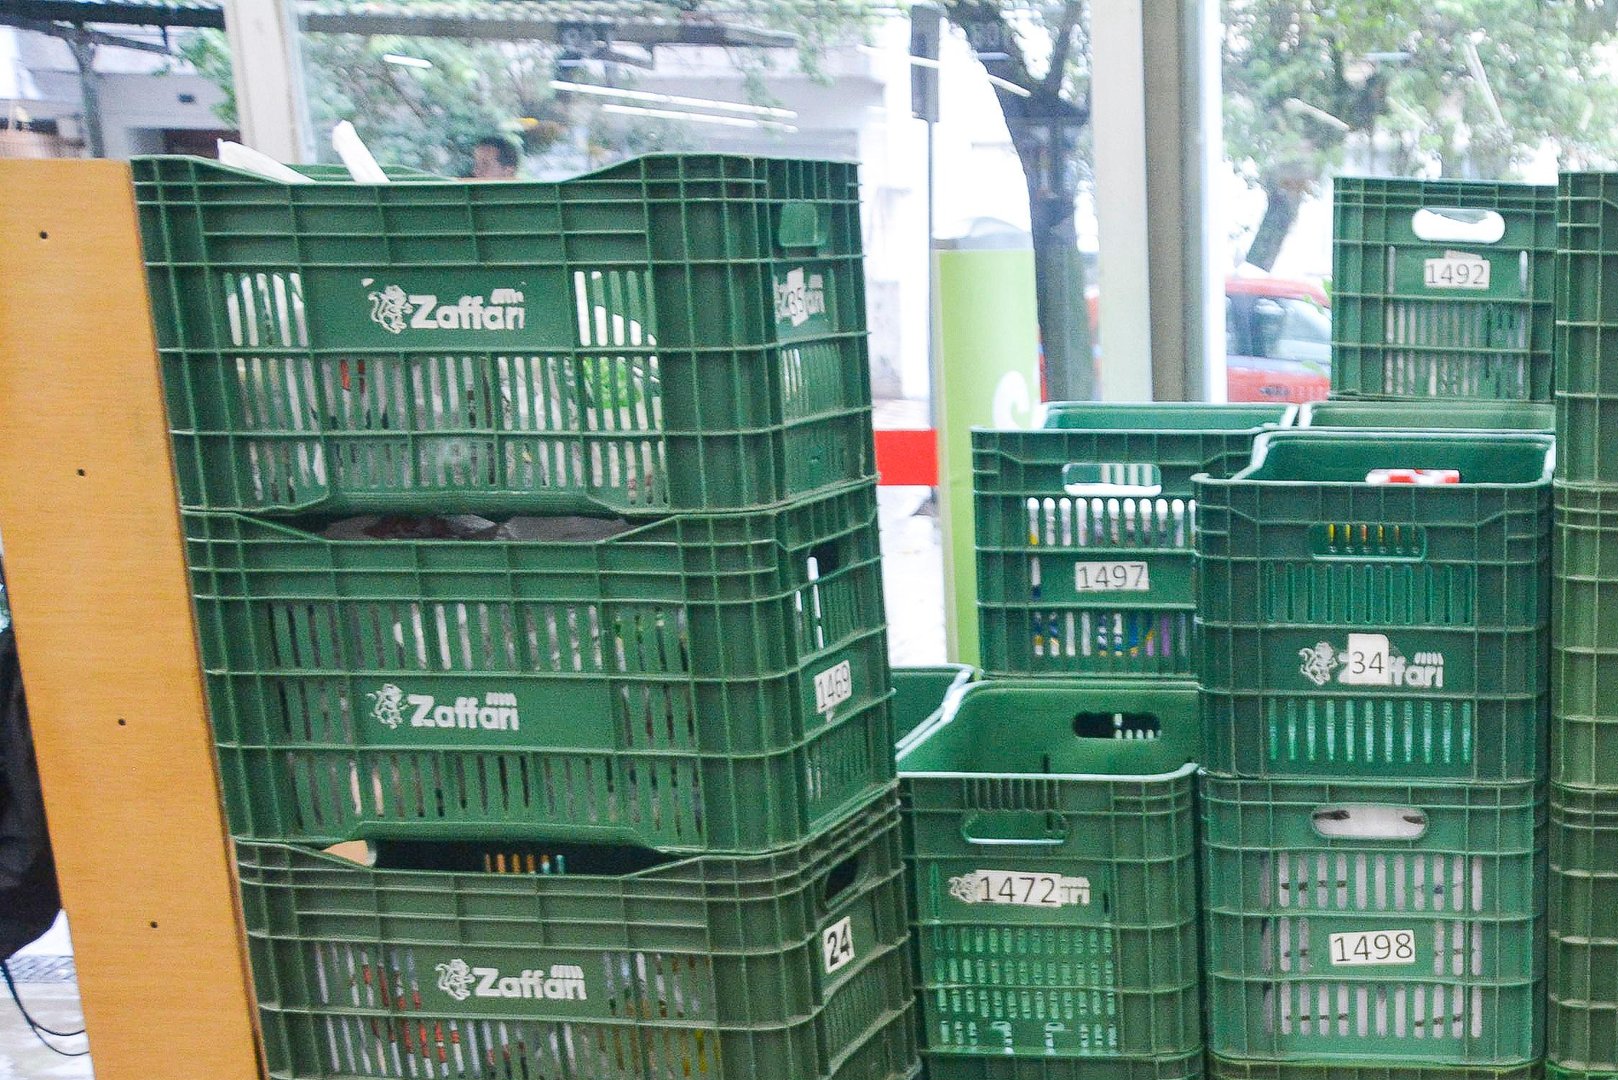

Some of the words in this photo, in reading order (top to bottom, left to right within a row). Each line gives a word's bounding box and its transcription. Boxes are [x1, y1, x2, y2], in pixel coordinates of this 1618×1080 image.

[1426, 264, 1485, 285] 1492
[408, 288, 526, 330] Zaffari
[1079, 564, 1145, 588] 1497
[1352, 651, 1385, 675] 34
[818, 663, 850, 709] 1469
[407, 692, 520, 731] Zaffari
[980, 876, 1057, 904] 1472
[827, 923, 851, 966] 24
[1334, 933, 1413, 962] 1498
[471, 965, 588, 1000] Zaffari
